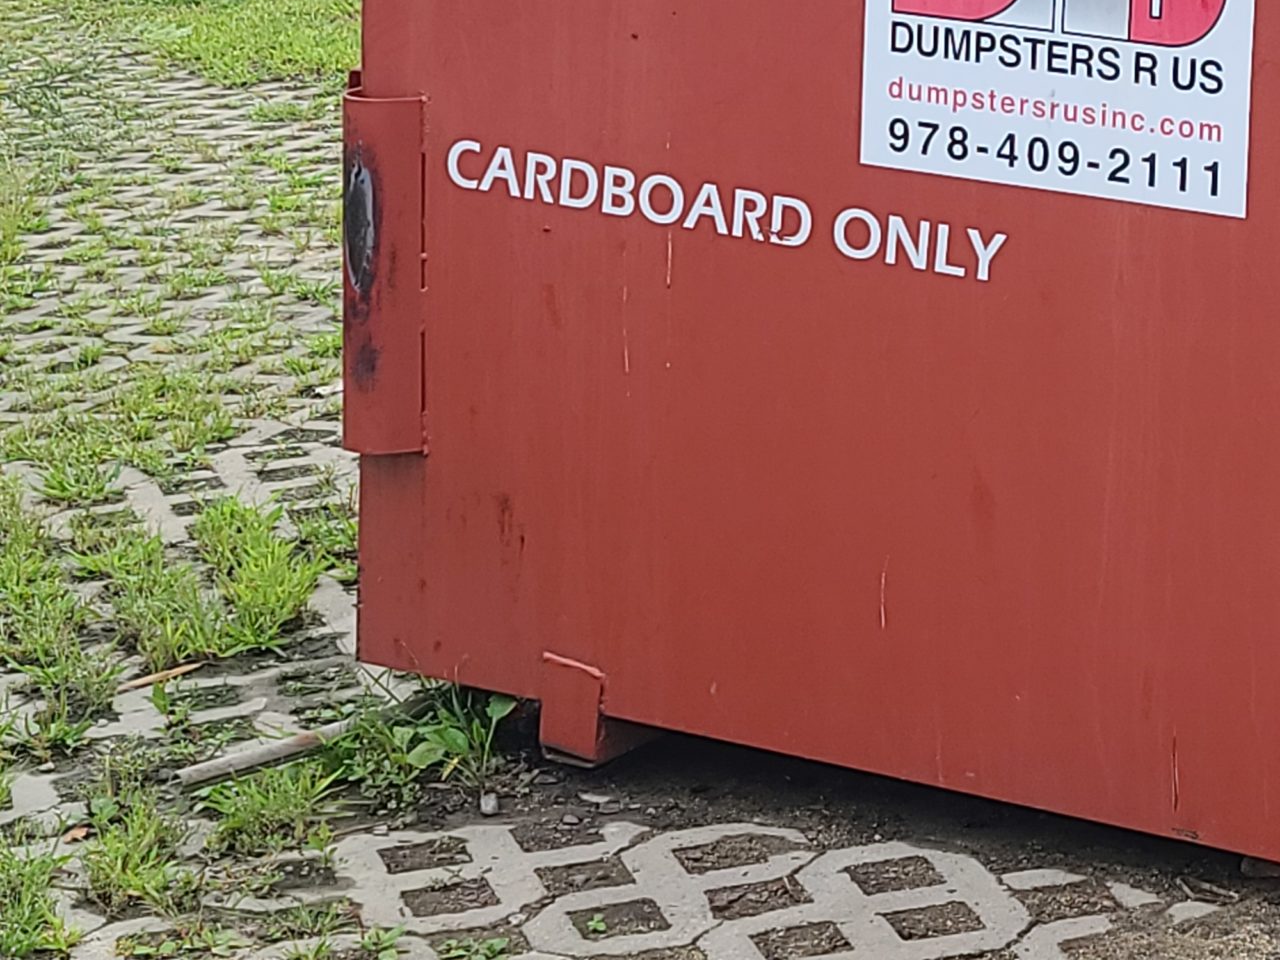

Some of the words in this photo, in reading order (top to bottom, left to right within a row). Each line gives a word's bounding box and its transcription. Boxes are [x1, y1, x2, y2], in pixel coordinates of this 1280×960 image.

[891, 21, 1121, 81] DUMPSTERS
[1134, 52, 1158, 86] R
[1173, 58, 1224, 95] US
[888, 76, 1223, 142] dumpstersrusinc.com
[888, 118, 1220, 197] 978-409-2111
[446, 139, 812, 247] CARDBOARD
[833, 207, 1008, 282] ONLY
